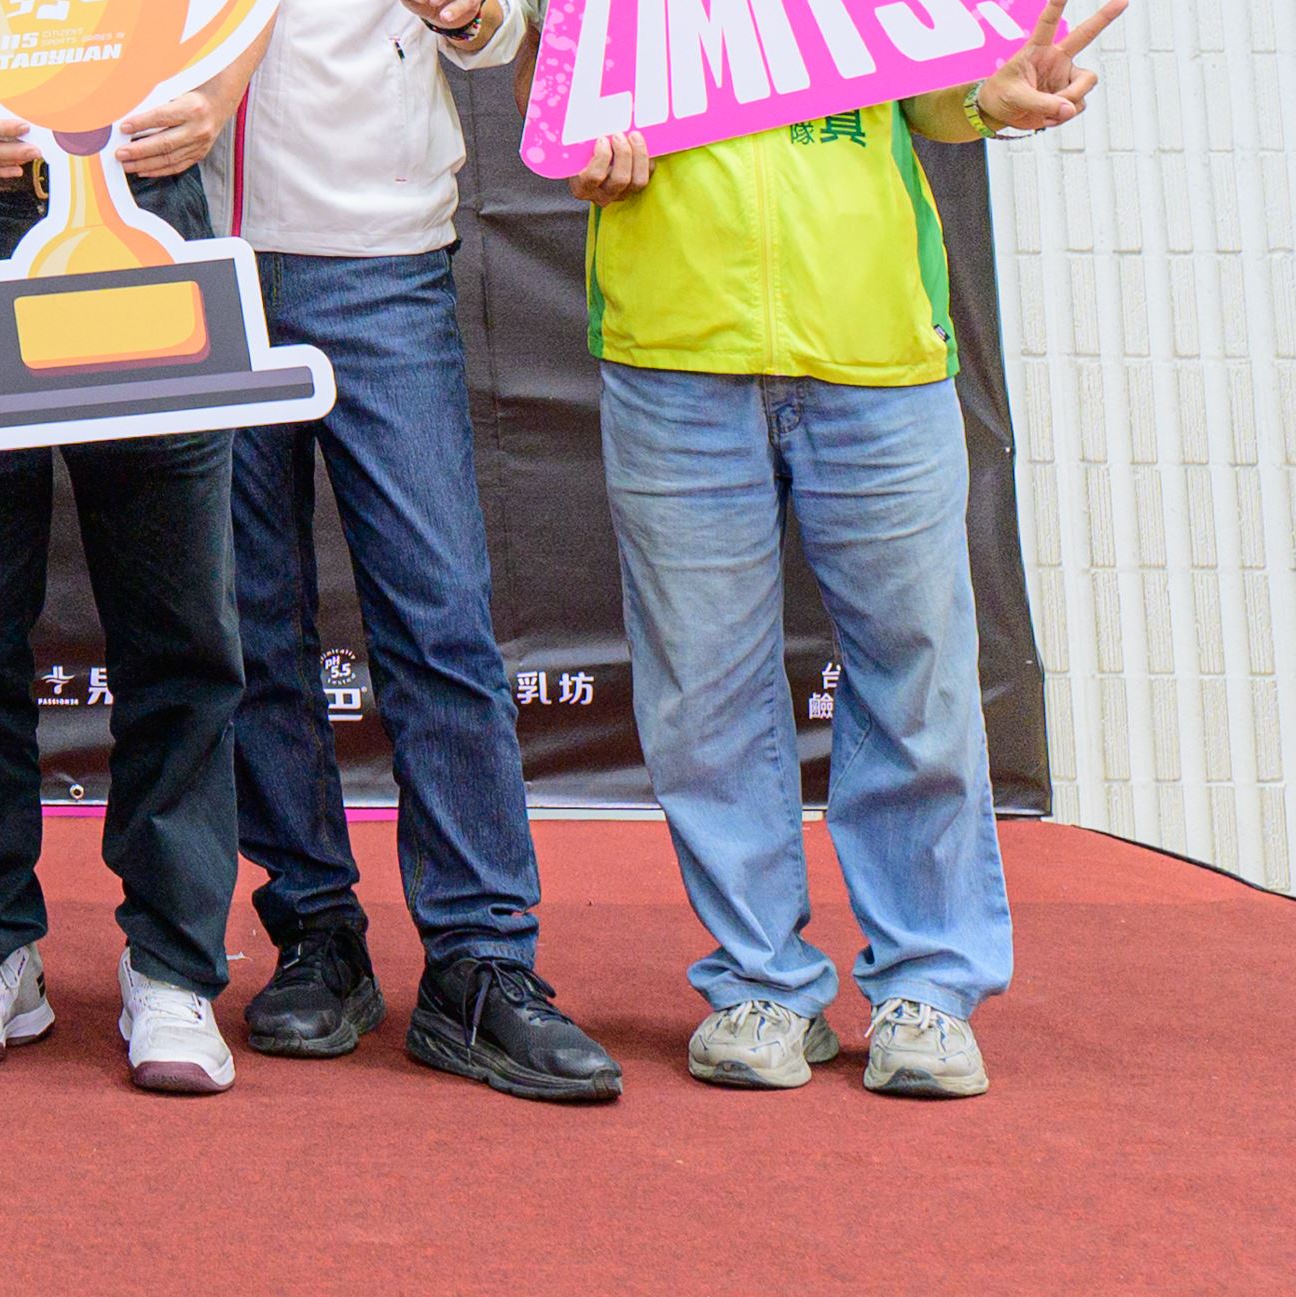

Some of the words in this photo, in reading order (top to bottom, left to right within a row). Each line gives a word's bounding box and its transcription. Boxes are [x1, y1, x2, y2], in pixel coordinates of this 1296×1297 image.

[0, 31, 40, 50] 115
[0, 43, 122, 70] TAOYUAN
[330, 662, 351, 679] 5.5
[516, 671, 594, 704] 乳坊
